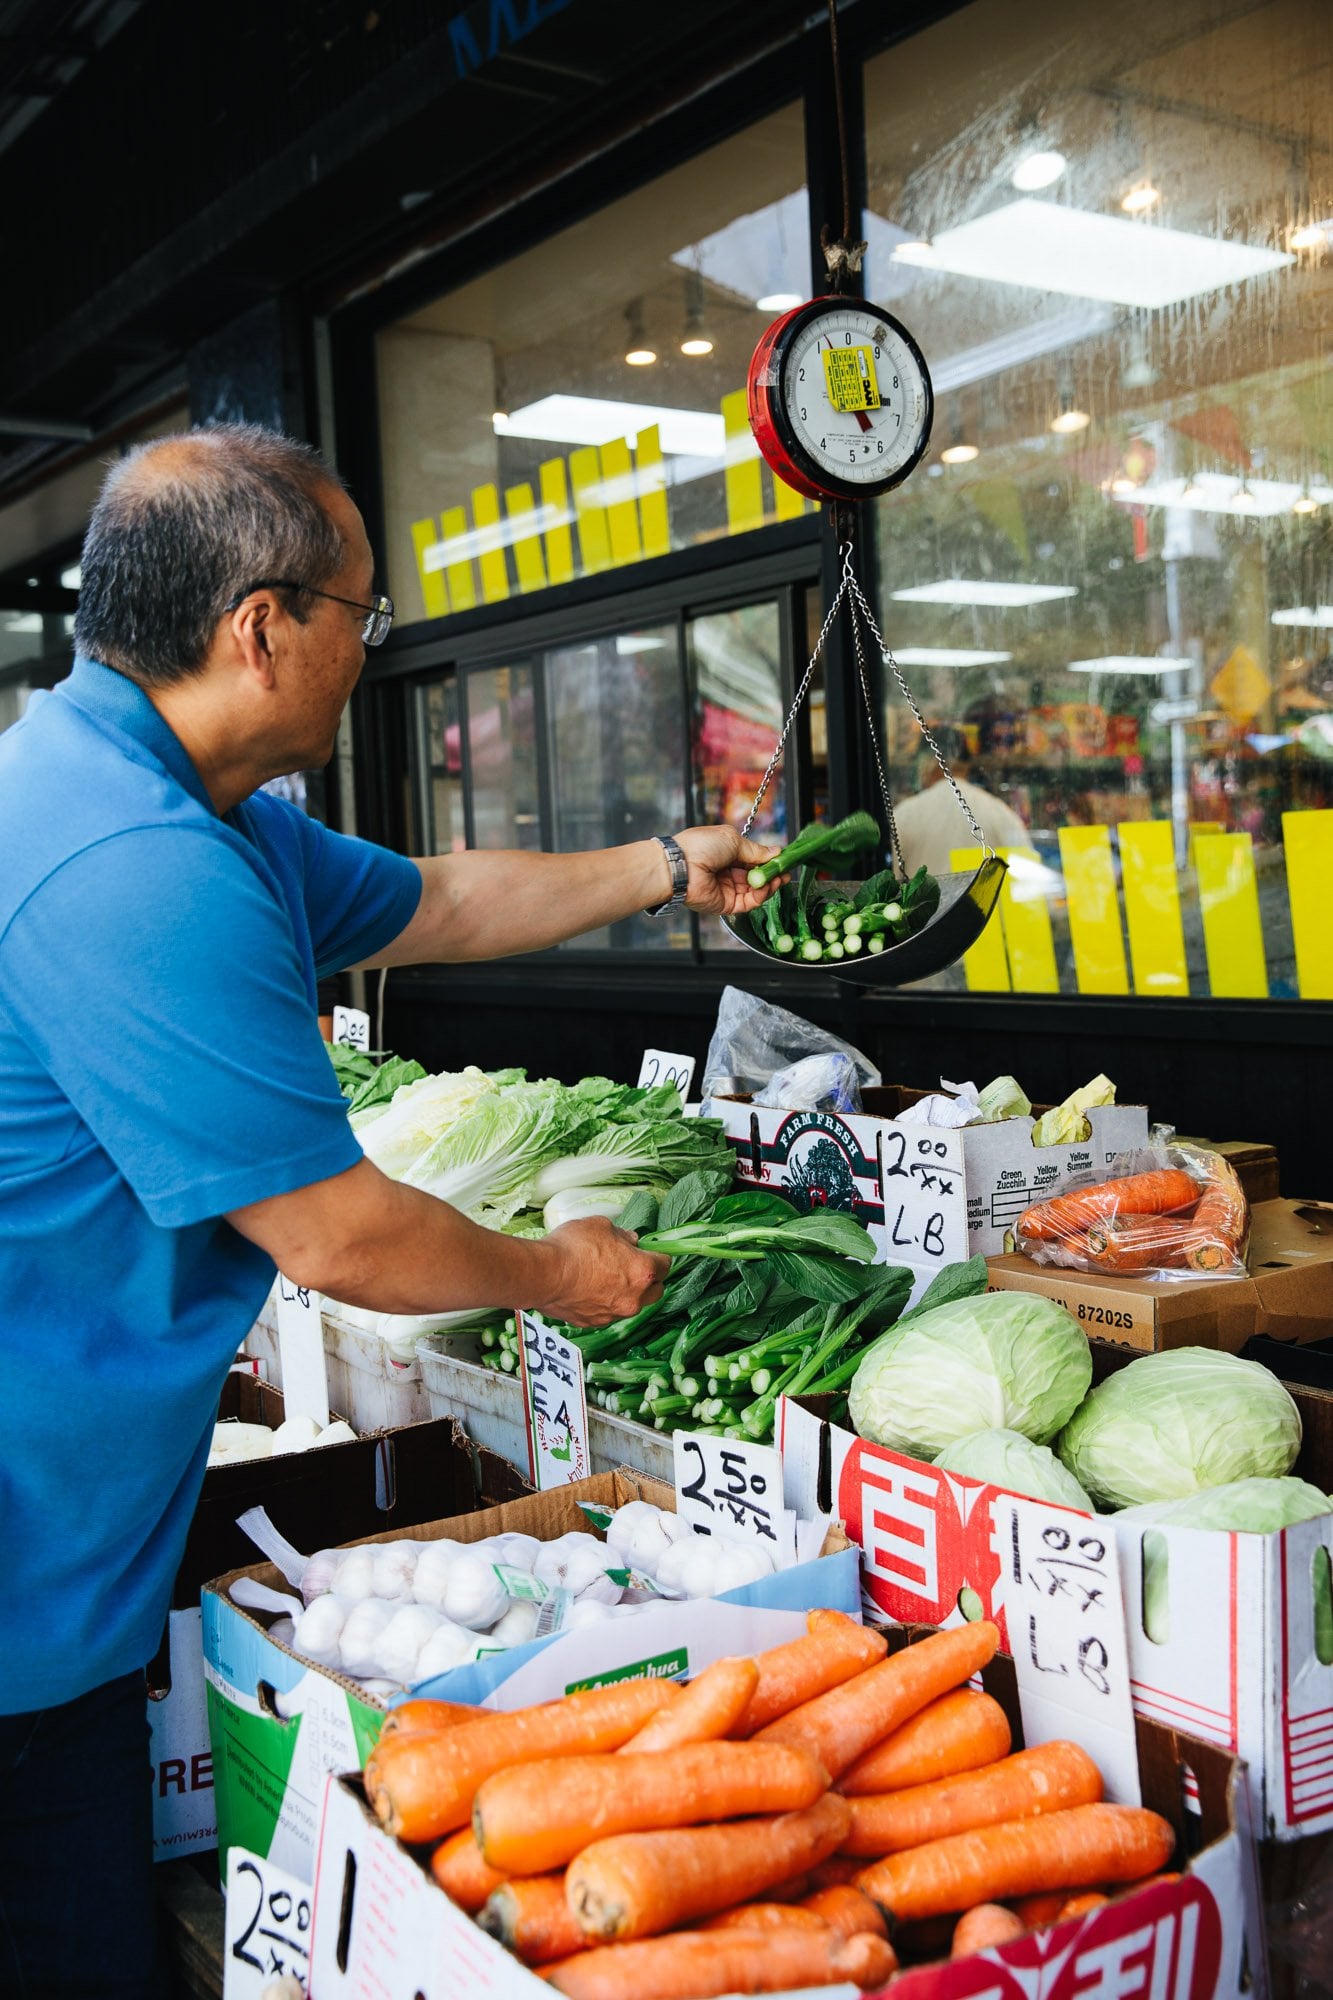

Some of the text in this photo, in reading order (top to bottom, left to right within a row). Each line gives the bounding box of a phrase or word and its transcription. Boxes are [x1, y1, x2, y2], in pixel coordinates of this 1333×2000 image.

[845, 332, 851, 345] 0
[817, 341, 820, 354] 1
[874, 346, 880, 359] 9
[799, 368, 805, 381] 2
[893, 376, 898, 388] 8
[863, 380, 873, 406] NYC
[801, 408, 807, 421] 3
[895, 414, 900, 427] 7
[820, 438, 826, 450] 4
[877, 441, 883, 453] 6
[849, 450, 855, 462] 5
[780, 1113, 859, 1158] FARM FRESH
[1069, 1152, 1089, 1162] Yellow
[1037, 1165, 1058, 1176] Yellow
[1066, 1160, 1093, 1173] Summer
[1000, 1170, 1022, 1180] Green
[996, 1178, 1027, 1190] Zucchini
[967, 1197, 983, 1207] mall
[967, 1206, 991, 1218] edium
[967, 1220, 983, 1230] arge
[1077, 1303, 1133, 1330] 87202S
[537, 1411, 549, 1451] RESH
